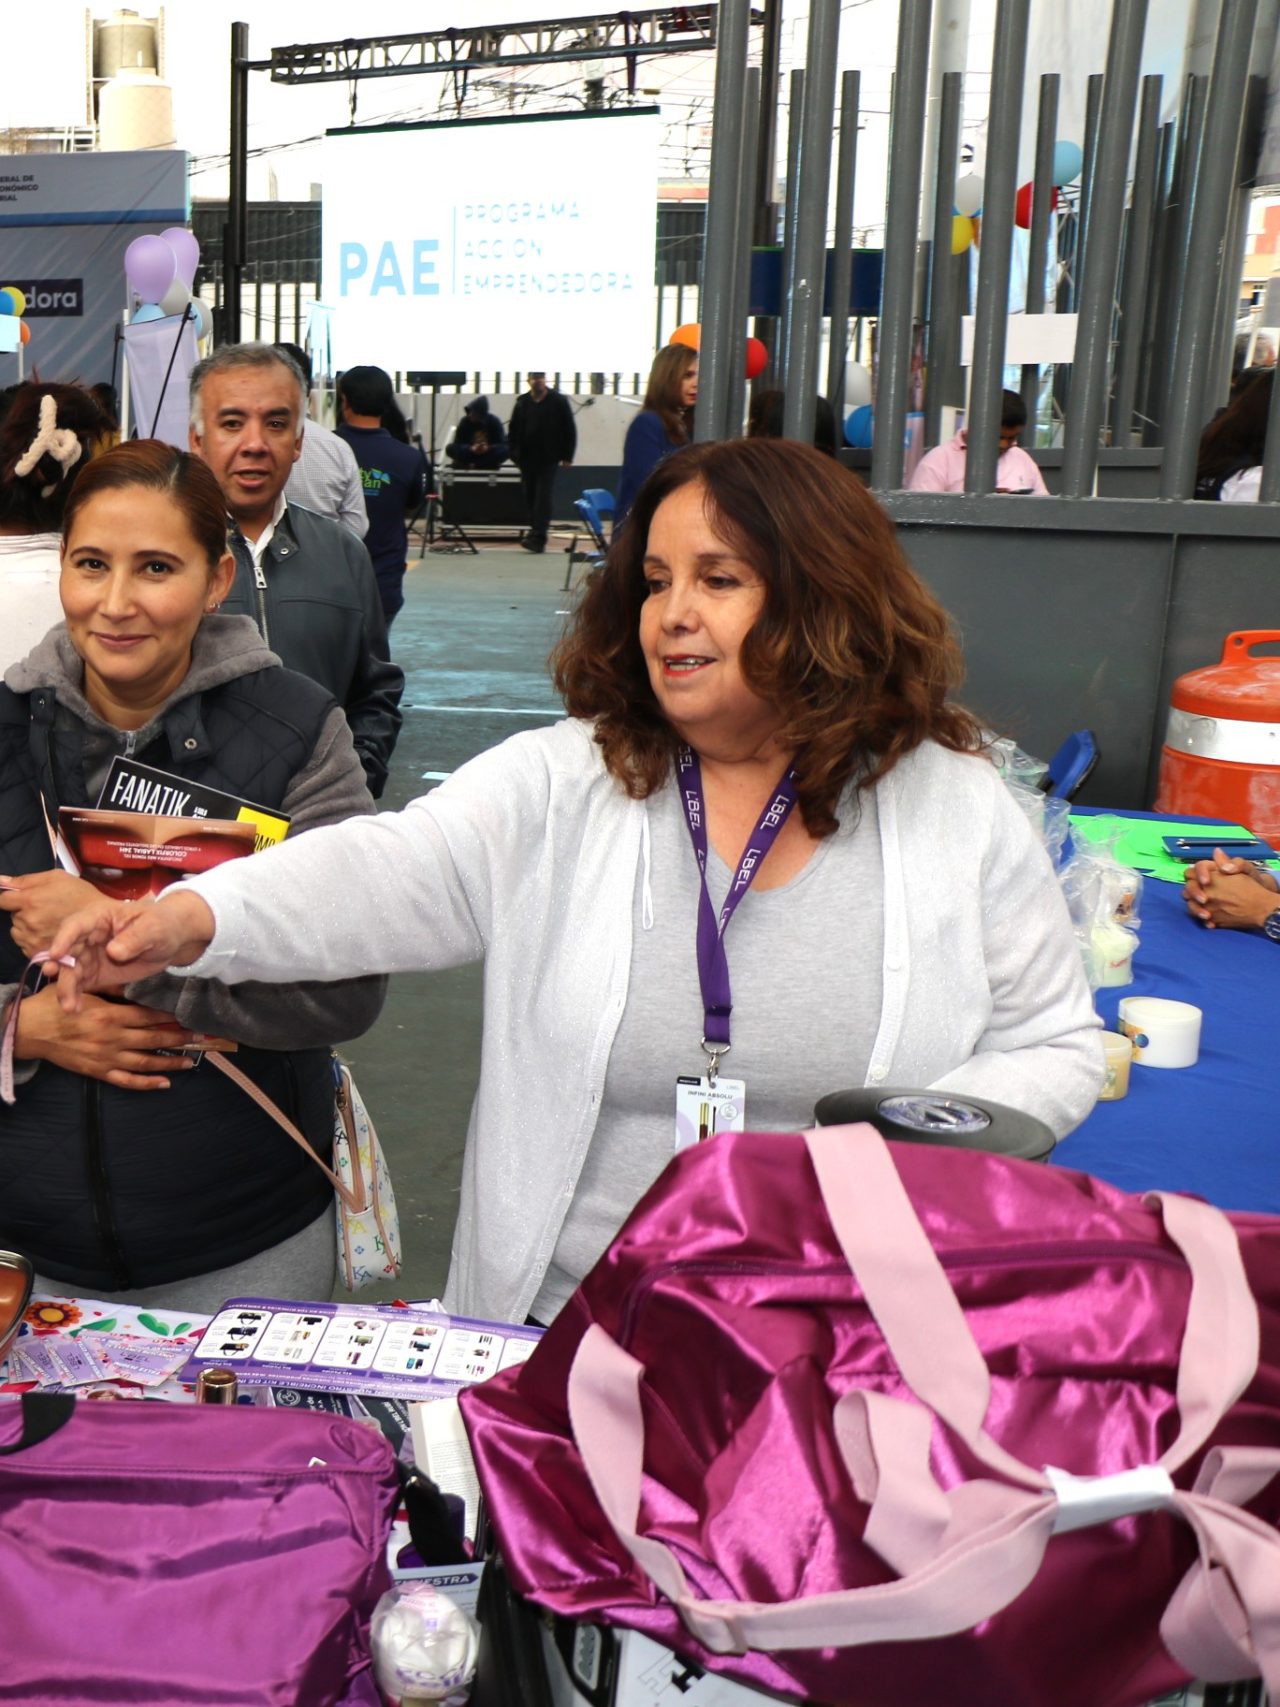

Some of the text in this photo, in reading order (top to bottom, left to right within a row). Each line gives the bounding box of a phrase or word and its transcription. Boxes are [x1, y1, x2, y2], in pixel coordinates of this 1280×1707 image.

[23, 174, 35, 182] DE
[464, 202, 580, 223] PROGRAMA
[339, 238, 441, 297] PAE
[463, 272, 633, 295] EMPRENDEDORA
[110, 771, 192, 817] FANATIK
[685, 790, 701, 831] L'BEL
[760, 794, 790, 830] L'BEL
[156, 850, 187, 858] COLORFIX
[734, 848, 761, 892] L'BEL
